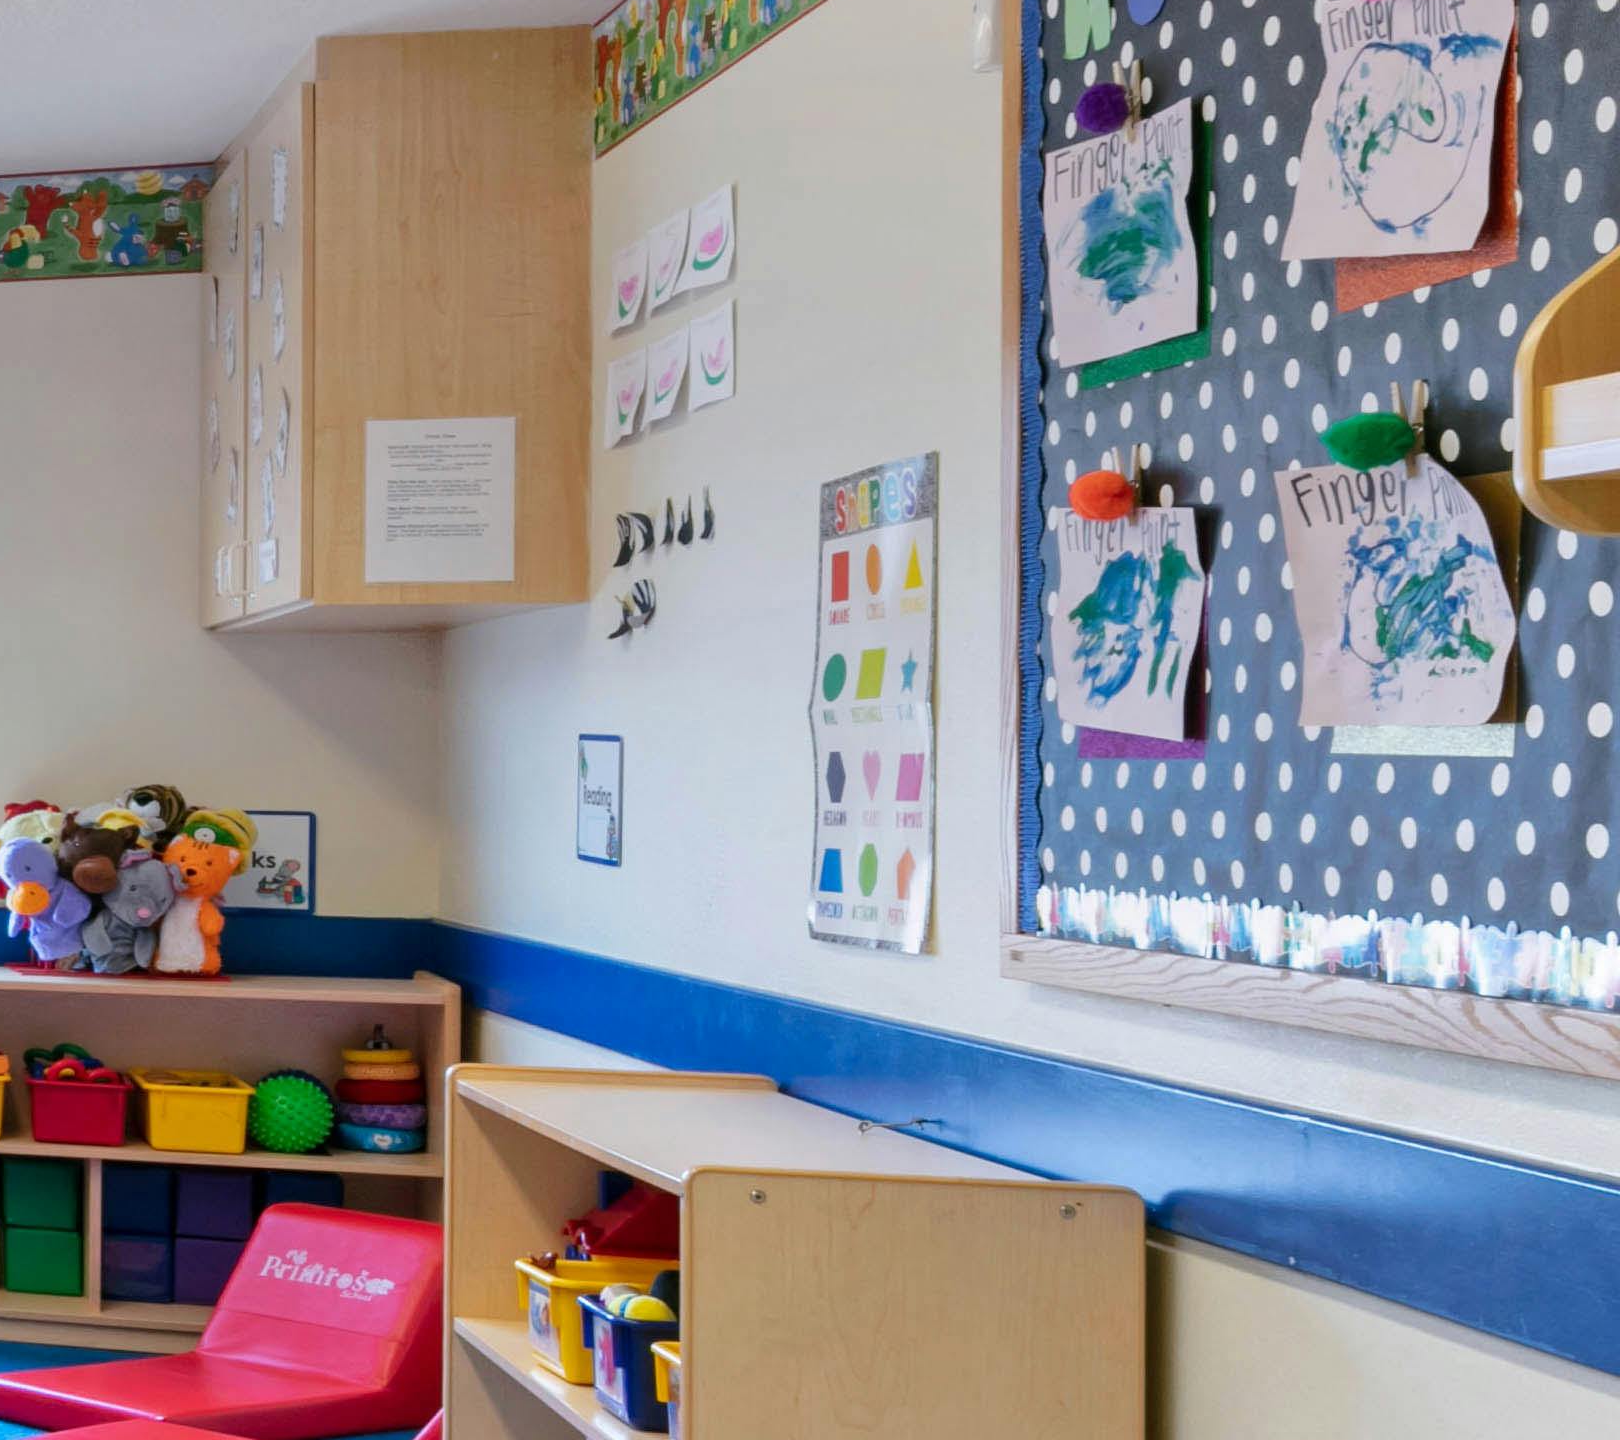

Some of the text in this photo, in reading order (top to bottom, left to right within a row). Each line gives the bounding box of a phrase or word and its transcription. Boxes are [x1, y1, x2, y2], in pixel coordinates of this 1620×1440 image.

[1053, 142, 1125, 203] Finger
[1292, 471, 1407, 528] Finger
[583, 784, 612, 814] Reading
